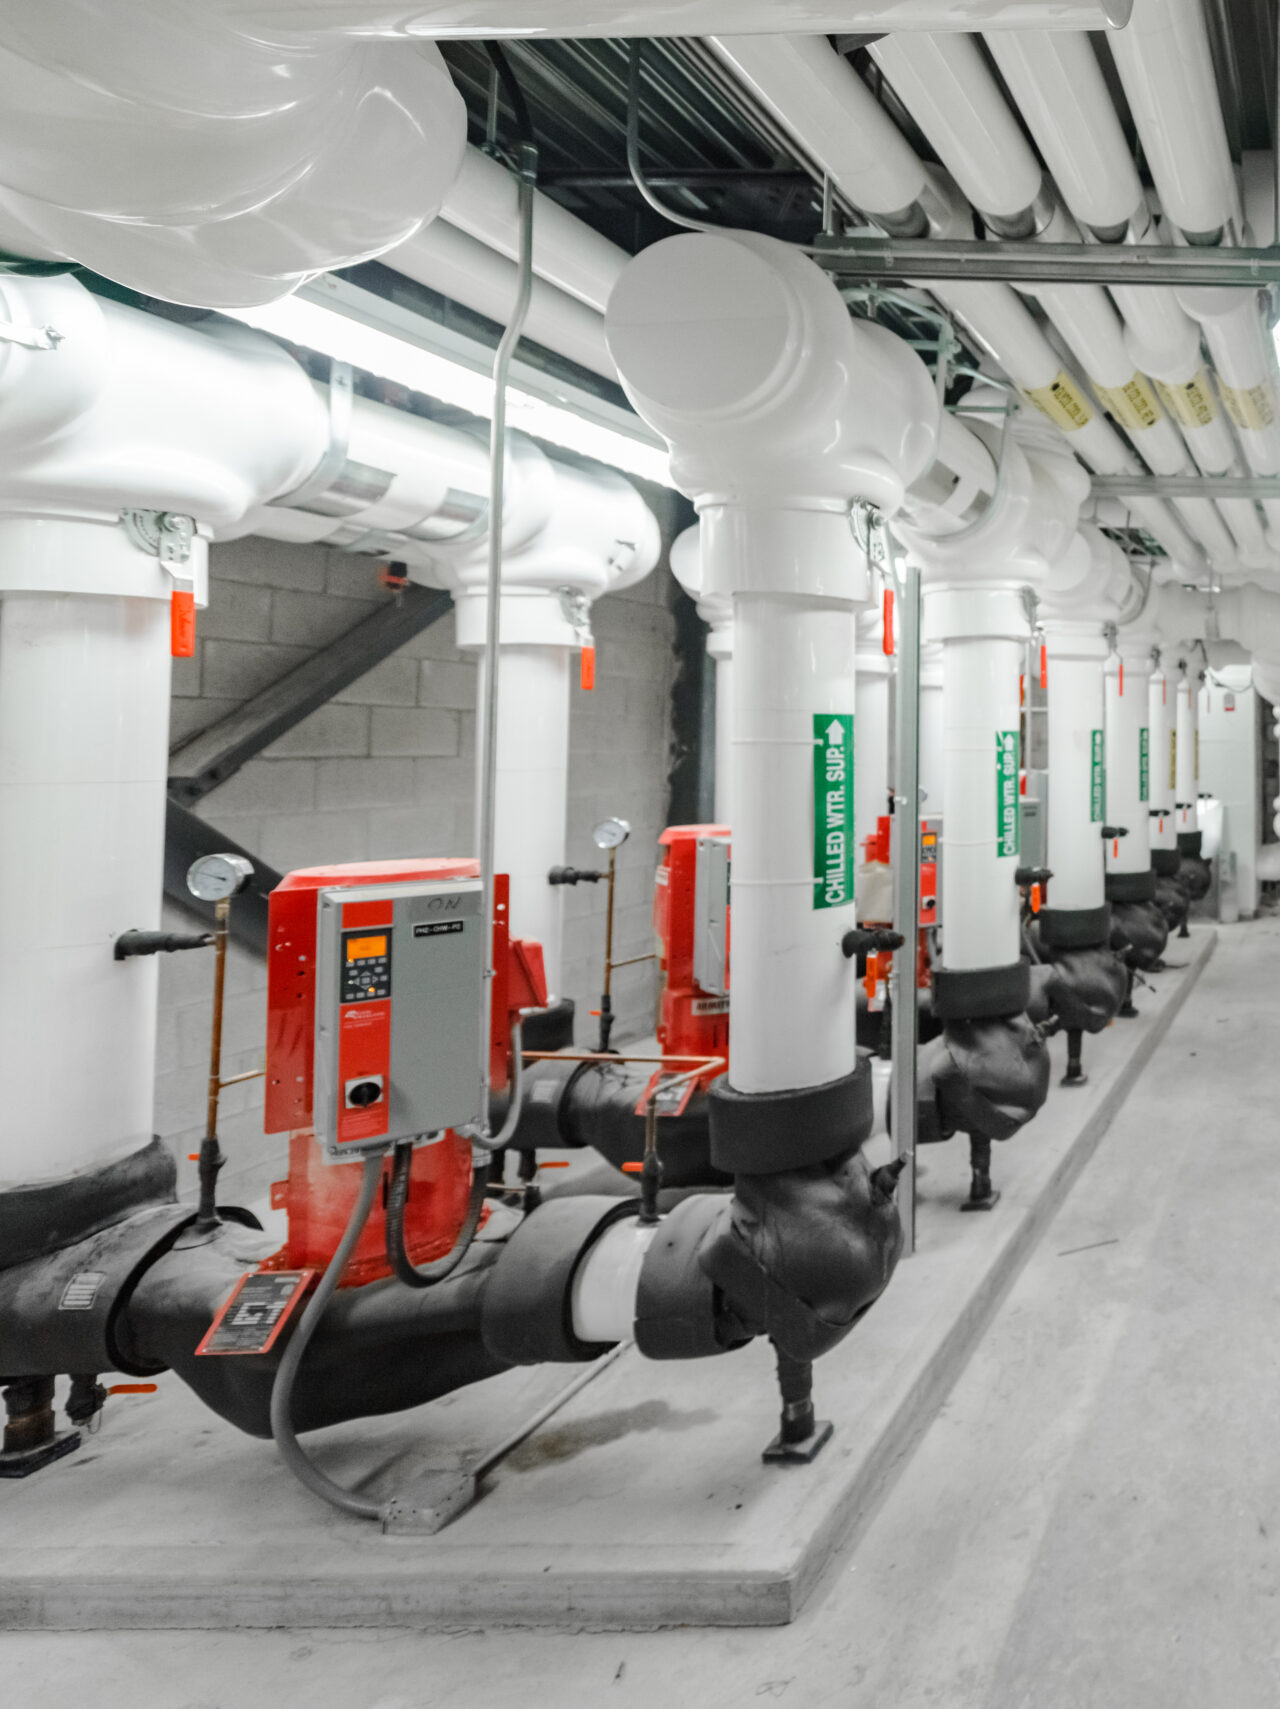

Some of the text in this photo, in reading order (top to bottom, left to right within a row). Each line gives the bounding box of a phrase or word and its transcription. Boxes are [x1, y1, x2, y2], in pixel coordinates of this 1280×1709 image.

[825, 746, 846, 904] CHILLED WTR. SUP.
[1003, 807, 1016, 855] CHILLED
[427, 897, 462, 912] ON
